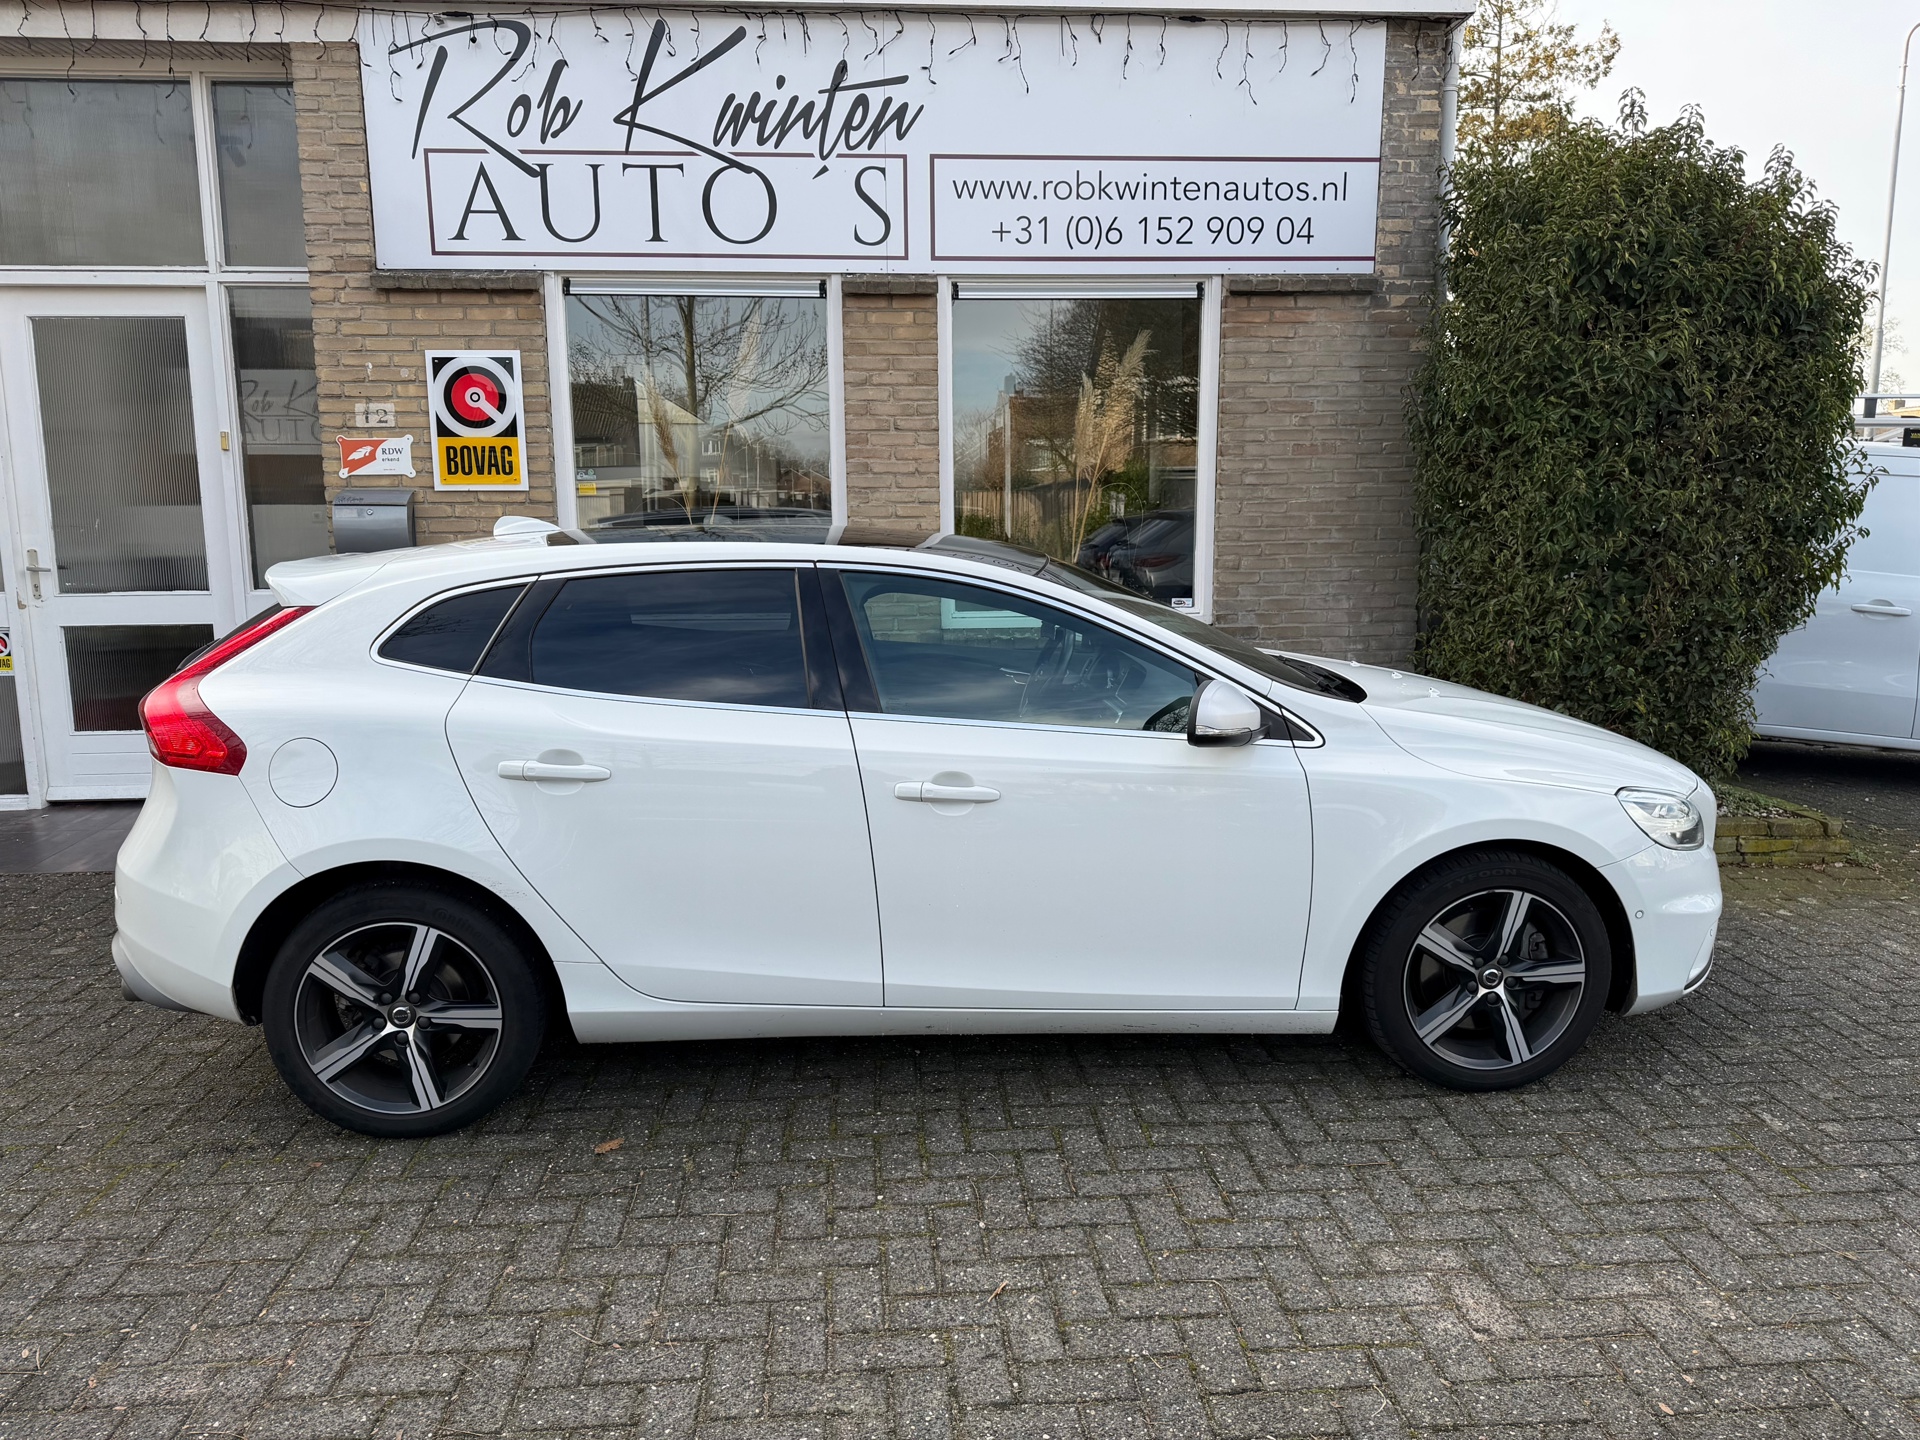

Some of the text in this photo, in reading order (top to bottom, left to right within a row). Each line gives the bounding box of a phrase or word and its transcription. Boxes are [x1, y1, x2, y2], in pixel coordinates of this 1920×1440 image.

[388, 19, 925, 177] Rob Kwinten
[952, 169, 1348, 202] www.robkwintenautos.nl
[992, 215, 1315, 250] +31 (0)6 152 909 04
[381, 447, 404, 455] RDW
[445, 445, 514, 476] BOVAG
[1443, 868, 1518, 890] TYFOON
